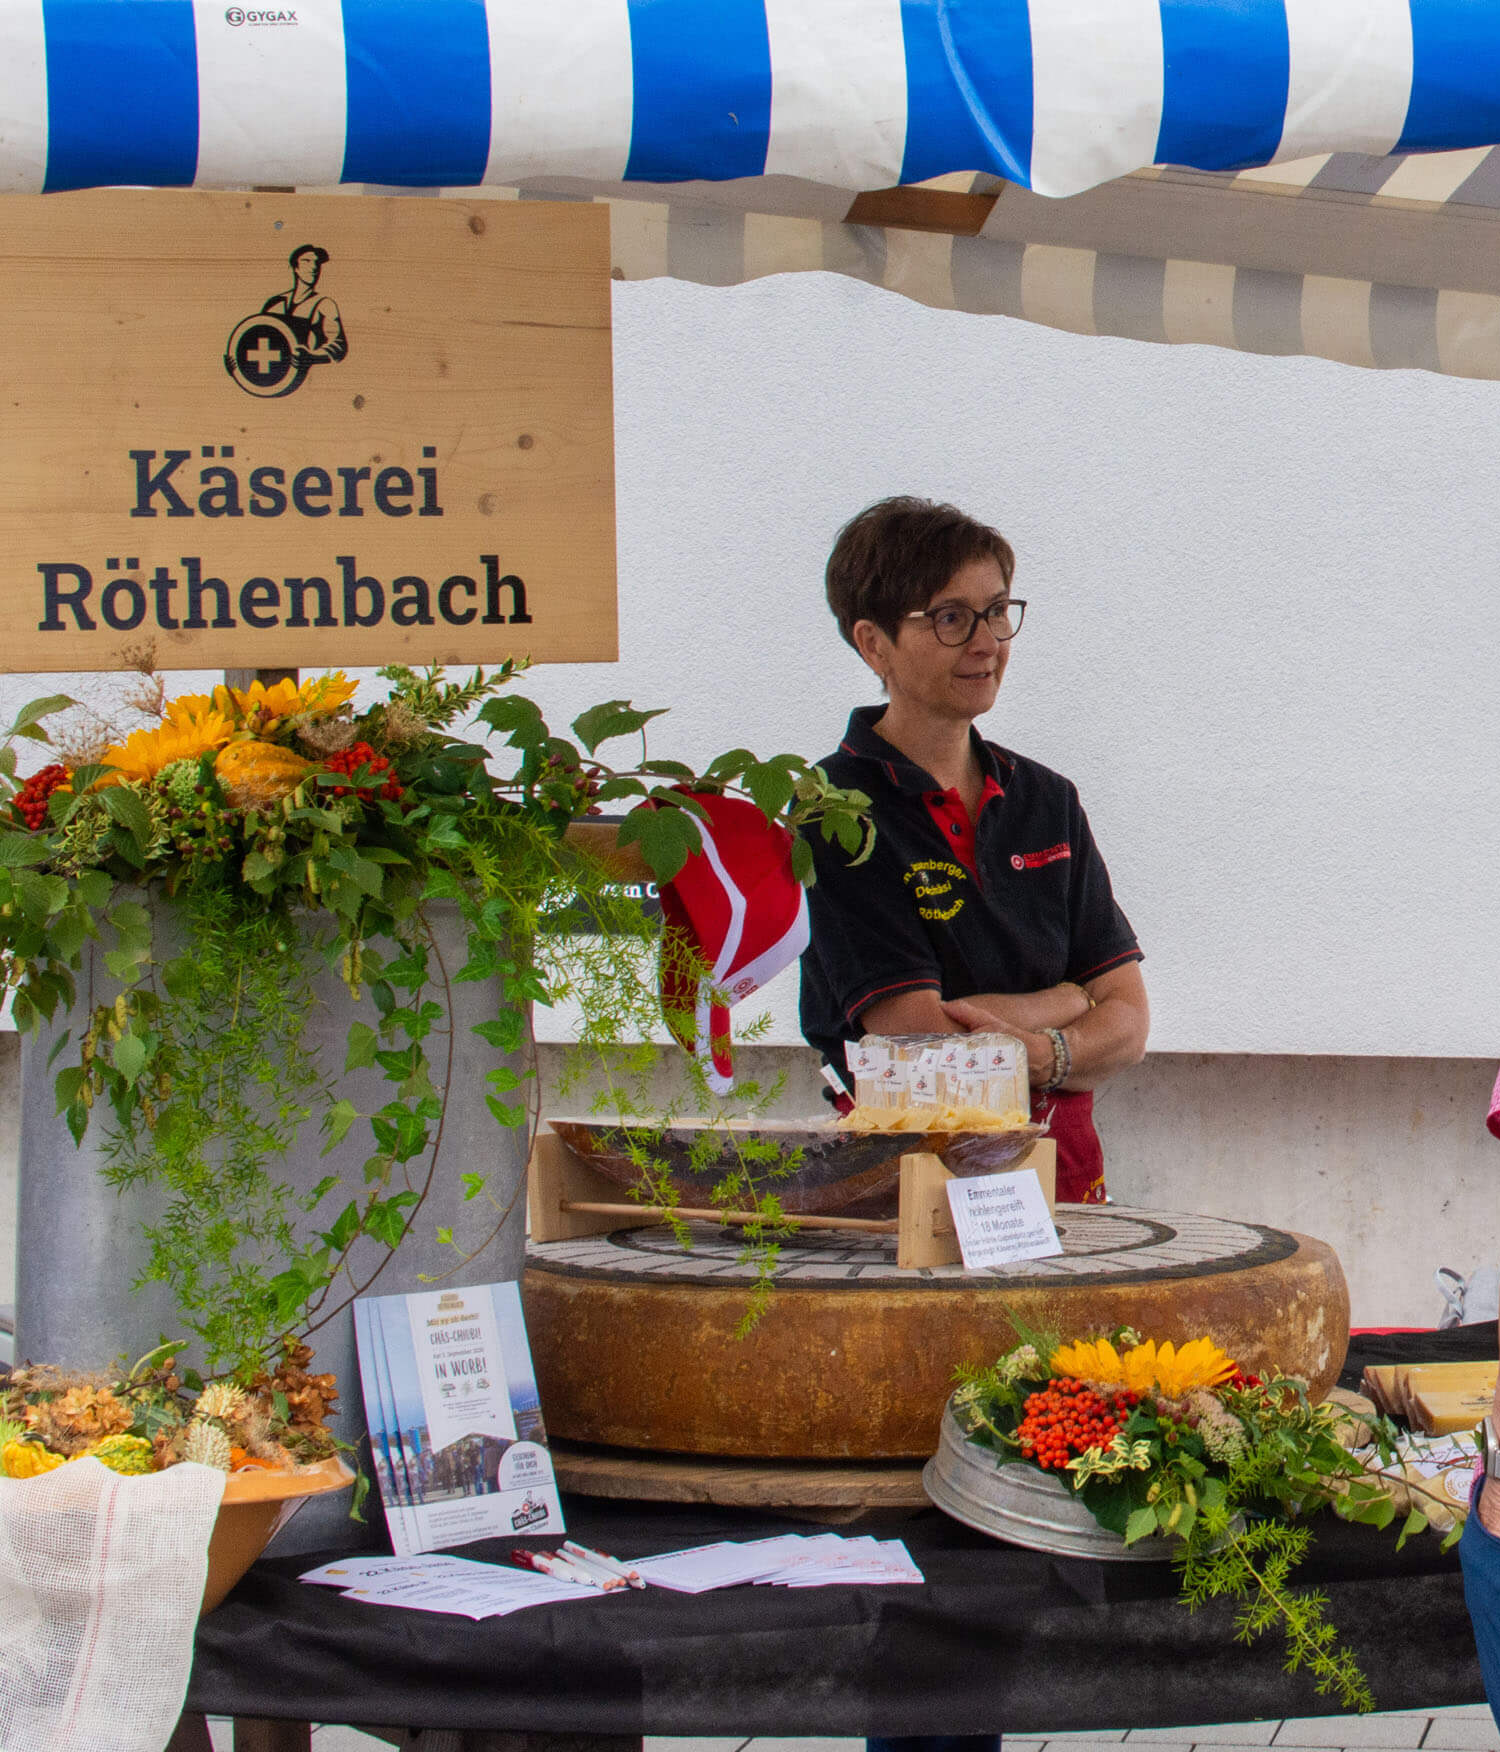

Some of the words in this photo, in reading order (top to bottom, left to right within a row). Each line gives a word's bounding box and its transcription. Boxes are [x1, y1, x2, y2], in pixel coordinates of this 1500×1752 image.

[247, 10, 298, 22] GYGAX
[129, 446, 444, 518] Käserei
[37, 554, 533, 632] Röthenbach
